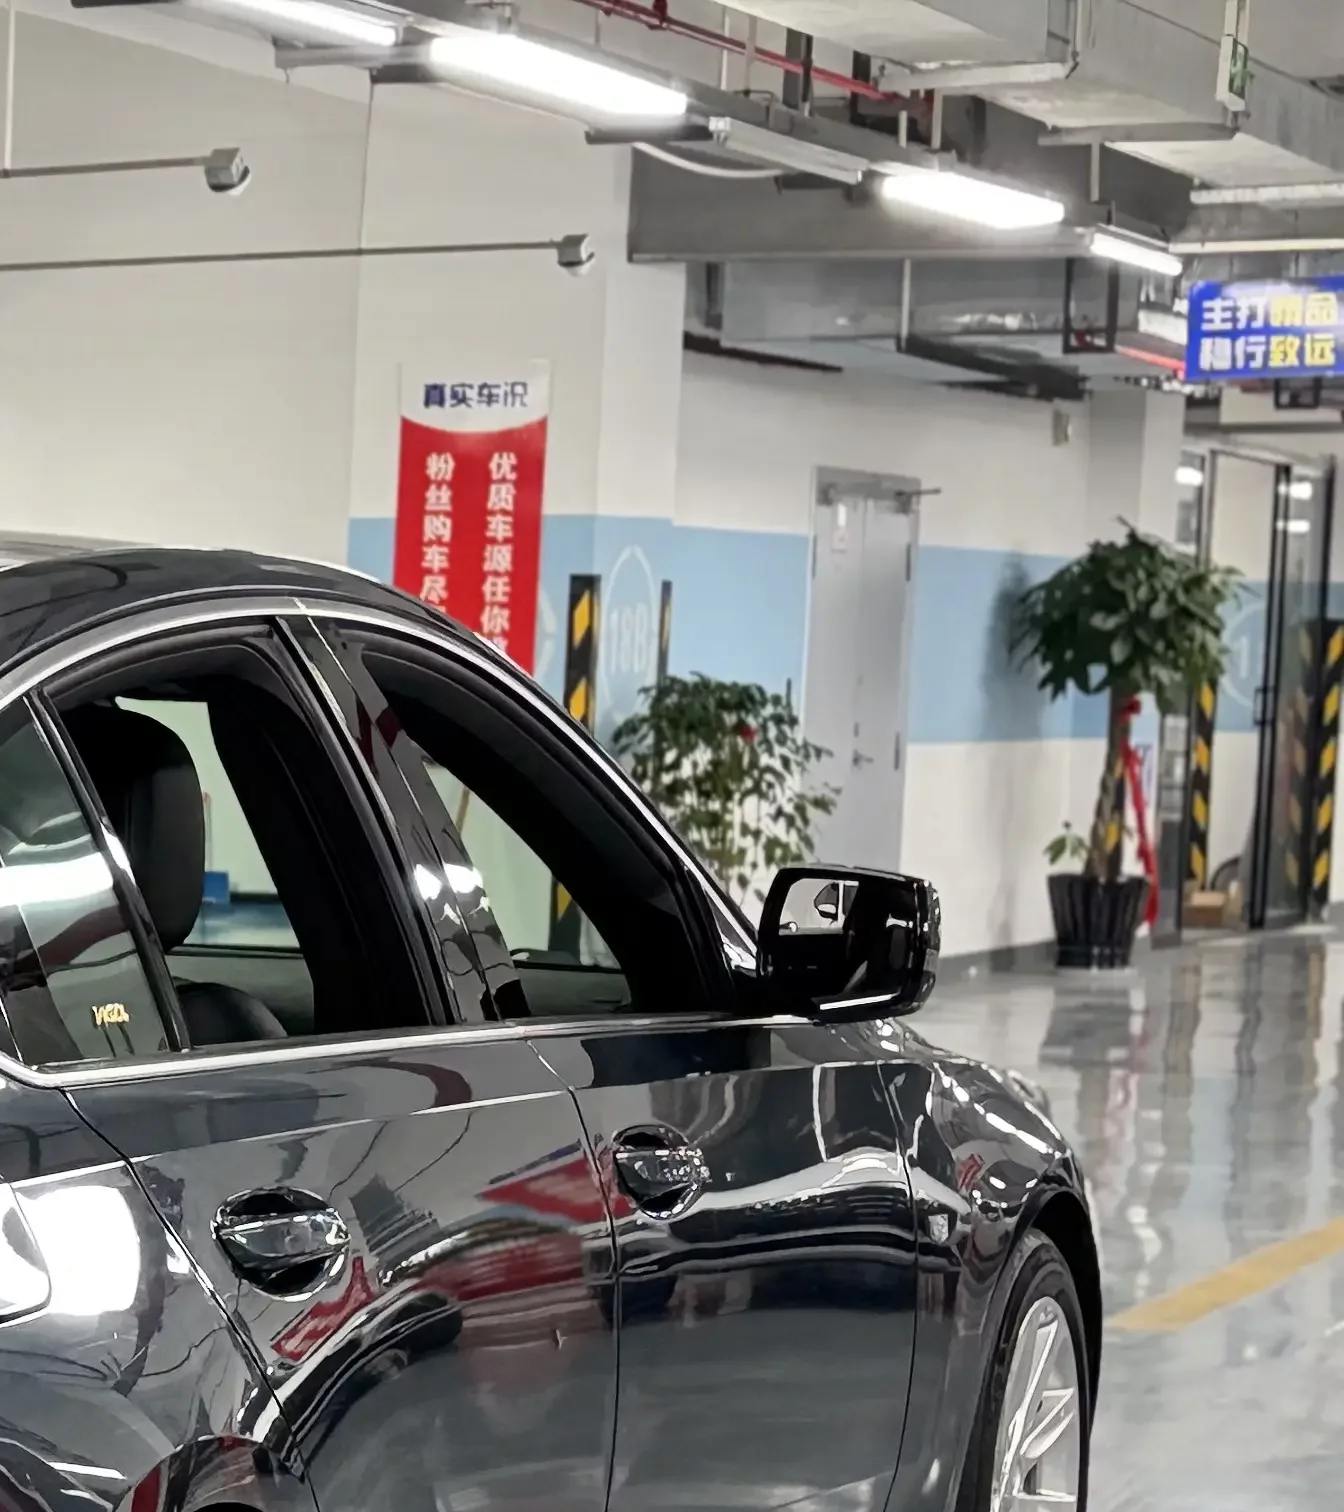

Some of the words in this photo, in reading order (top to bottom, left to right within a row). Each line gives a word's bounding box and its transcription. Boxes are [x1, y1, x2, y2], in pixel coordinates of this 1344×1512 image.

[423, 382, 527, 408] 真实车况
[419, 452, 455, 613] 粉丝购车尽
